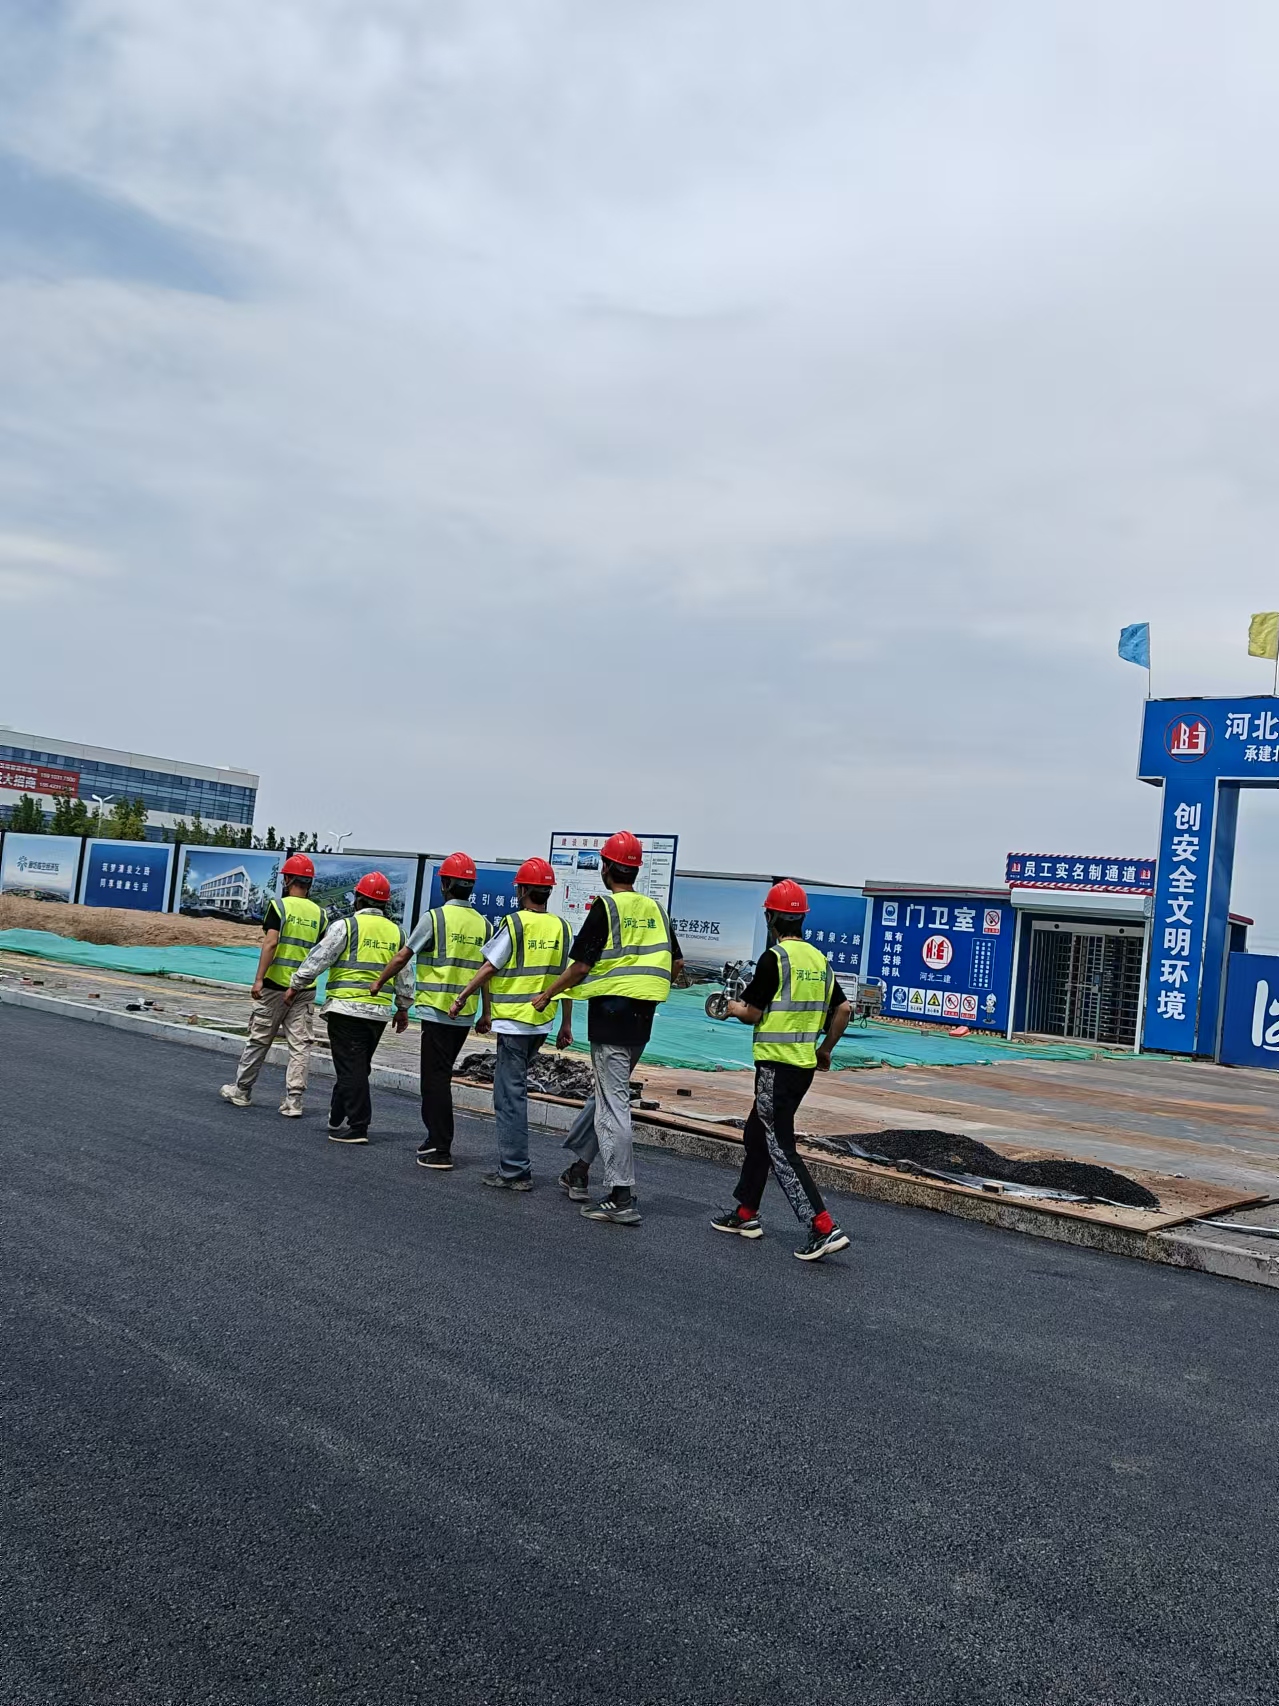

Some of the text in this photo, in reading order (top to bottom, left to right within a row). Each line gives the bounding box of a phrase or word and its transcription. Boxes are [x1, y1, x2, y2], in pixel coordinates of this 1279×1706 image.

[1225, 712, 1279, 740] 河北
[561, 838, 608, 847] 建设项目
[1024, 861, 1136, 883] 员工实名制通道
[905, 904, 976, 932] 门卫室
[1157, 803, 1201, 1020] 创安全文明环境
[287, 914, 317, 929] 河北二建
[624, 917, 657, 929] 河北二建
[671, 917, 721, 935] 临空经济区
[363, 938, 397, 952] 河北二建
[451, 933, 483, 946] 河北二建
[527, 939, 560, 951] 河北二建
[804, 929, 861, 946] 梦清泉之路
[826, 951, 859, 965] 康生活
[881, 931, 893, 977] 服从安排
[891, 932, 904, 977] 有序排队
[796, 969, 827, 981] 河北二建
[920, 972, 952, 984] 河北二建
